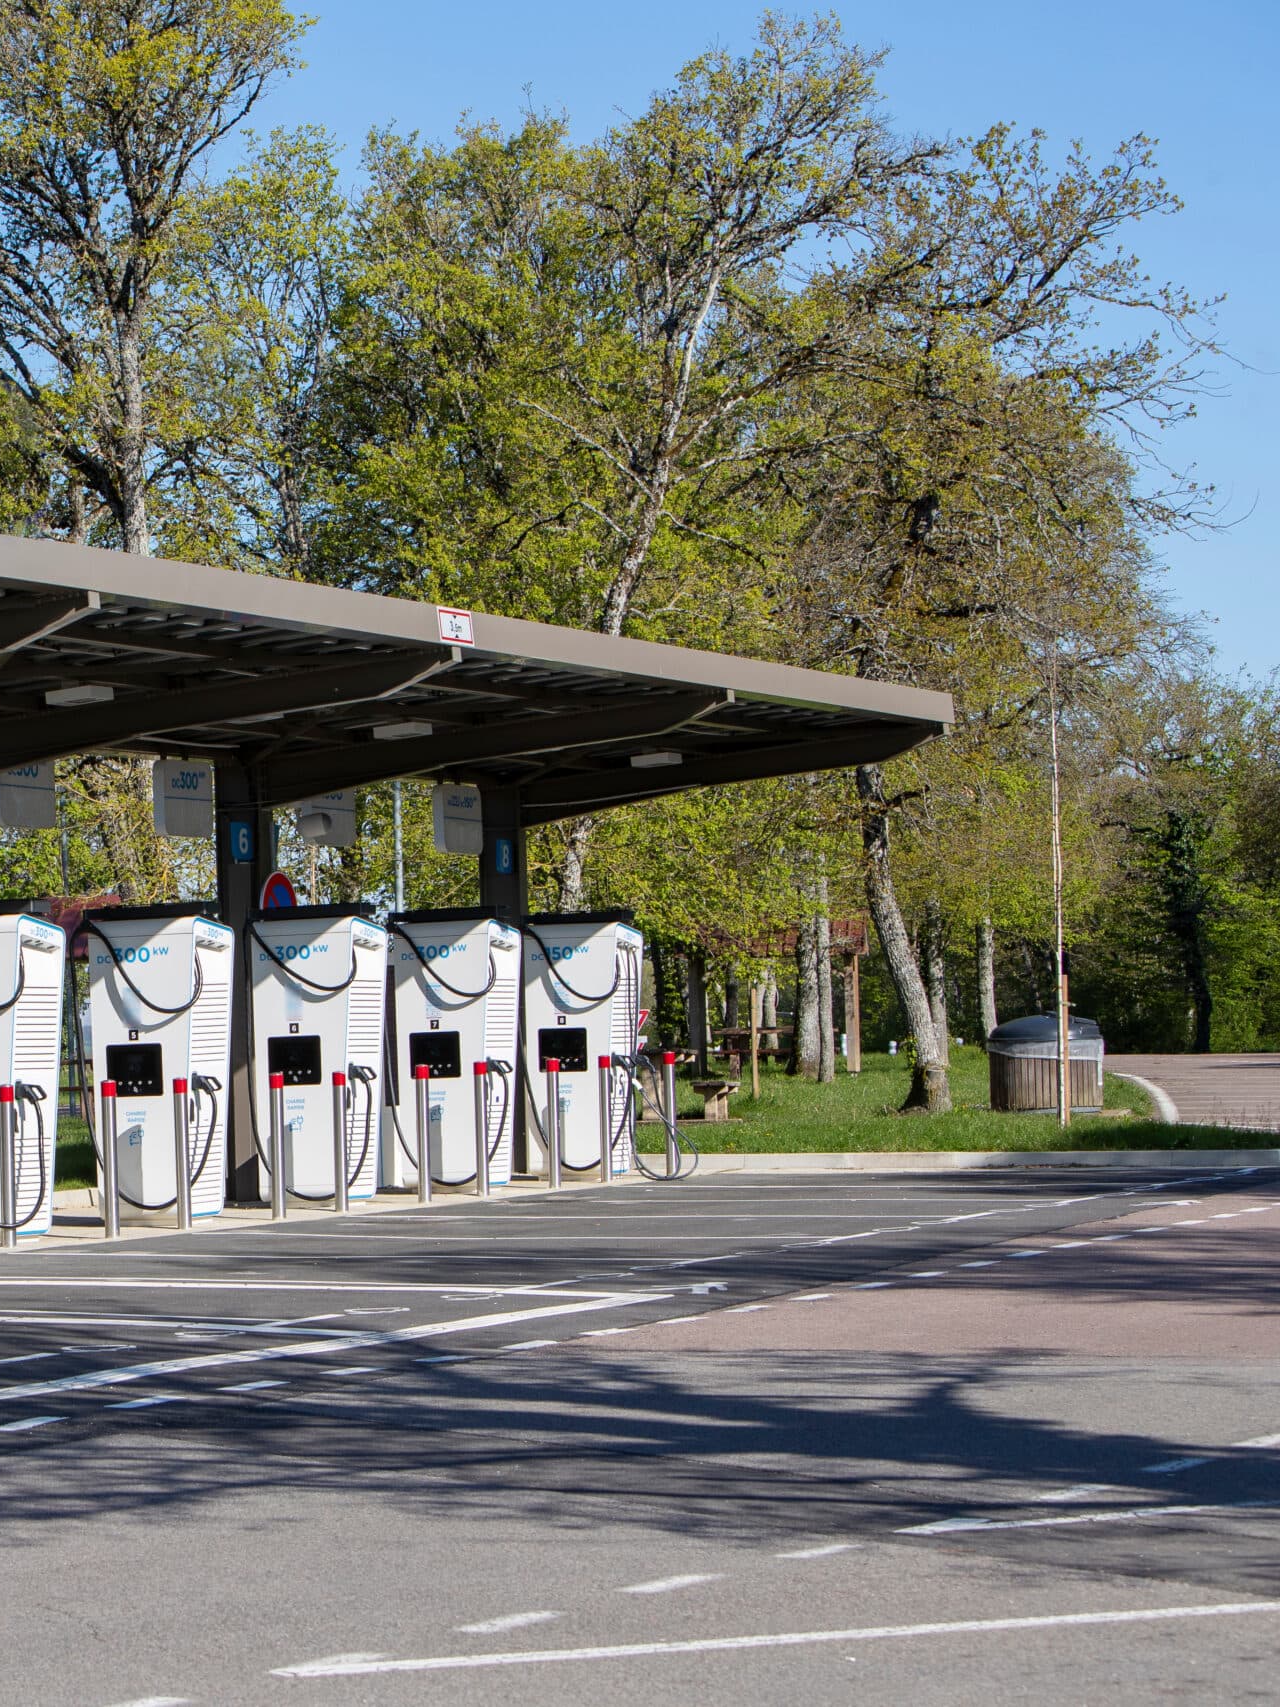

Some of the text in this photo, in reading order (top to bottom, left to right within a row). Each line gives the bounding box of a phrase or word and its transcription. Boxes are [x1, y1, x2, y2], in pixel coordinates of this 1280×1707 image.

[238, 827, 249, 854] 6
[501, 844, 510, 868] 8
[96, 946, 169, 964] DC 300 kW
[274, 944, 311, 960] 300
[312, 944, 329, 953] kW
[401, 952, 415, 961] DC
[452, 943, 467, 953] kW
[531, 953, 545, 961] DC
[574, 945, 590, 954] kW
[291, 1024, 297, 1033] 6
[431, 1021, 438, 1029] 7
[131, 1031, 137, 1040] 5
